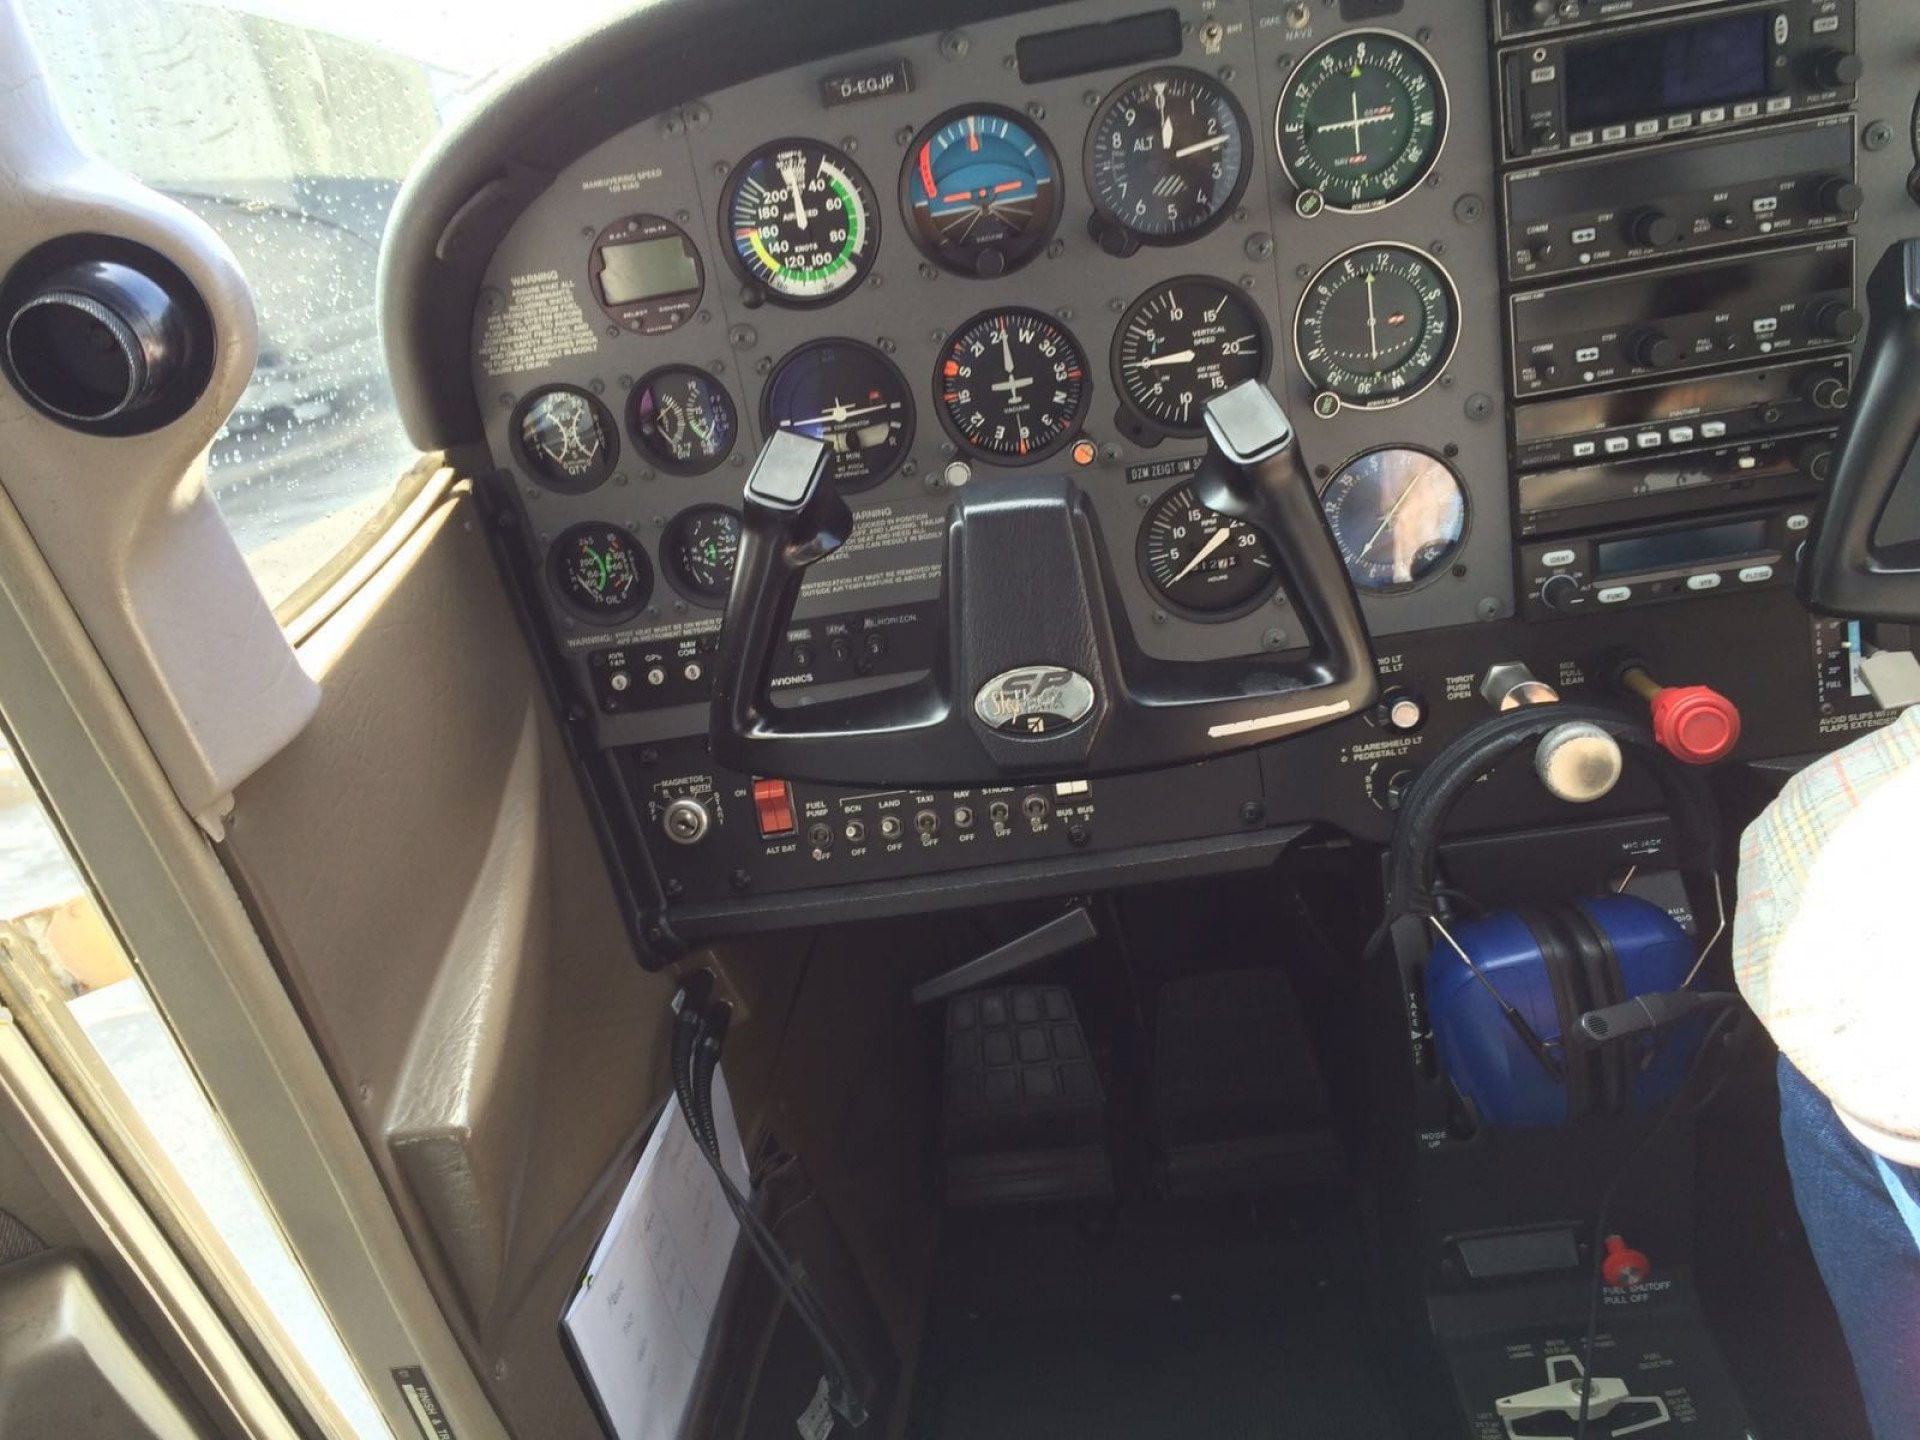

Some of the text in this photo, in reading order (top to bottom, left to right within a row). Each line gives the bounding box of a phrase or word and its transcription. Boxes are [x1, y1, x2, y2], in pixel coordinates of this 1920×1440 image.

[1295, 82, 1309, 99] 12
[1125, 108, 1136, 127] 9
[1420, 110, 1434, 126] W
[1207, 117, 1218, 135] 2
[1285, 122, 1299, 133] E
[1111, 131, 1122, 149] 8
[1133, 136, 1154, 152] ALT
[1211, 162, 1223, 180] 3
[582, 168, 663, 191] MANEUVERING SPEED
[808, 178, 826, 193] 40
[1381, 172, 1399, 190] 33
[762, 189, 788, 205] 200
[1118, 182, 1128, 200] 7
[1197, 188, 1208, 204] 4
[1351, 185, 1362, 200] N
[1712, 192, 1729, 202] NAV
[825, 197, 842, 211] 60
[1135, 198, 1147, 216] 6
[758, 206, 779, 220] 180
[1167, 203, 1178, 220] 5
[758, 225, 779, 239] 160
[829, 228, 846, 243] 80
[768, 239, 789, 254] 140
[794, 242, 818, 253] KNOTS
[784, 254, 806, 269] 120
[811, 252, 833, 266] 100
[1376, 252, 1390, 266] 12
[1344, 259, 1355, 274] E
[1408, 262, 1422, 277] 15
[510, 269, 559, 287] WARNING
[1317, 284, 1328, 295] 6
[1428, 287, 1442, 301] S
[1170, 308, 1183, 321] 10
[1203, 310, 1217, 323] 15
[1714, 313, 1730, 323] NAV
[1304, 317, 1316, 327] 3
[1432, 320, 1445, 335] 21
[1018, 328, 1036, 345] W
[1146, 329, 1156, 343] 5
[1192, 325, 1226, 337] VERTICAL
[1156, 336, 1165, 344] UP
[1193, 336, 1216, 347] SPEED
[970, 340, 985, 358] 21
[1038, 339, 1057, 358] 30
[1221, 341, 1240, 356] 20
[1307, 347, 1324, 361] N
[959, 366, 972, 378] S
[1053, 361, 1068, 382] 33
[1206, 363, 1221, 372] FEET
[1211, 377, 1225, 390] 15
[1326, 371, 1343, 387] 33
[1391, 374, 1406, 390] W
[1153, 382, 1163, 395] 5
[1357, 382, 1372, 395] 30
[958, 389, 972, 404] 15
[1052, 390, 1068, 405] N
[1179, 391, 1193, 405] 10
[1003, 404, 1031, 414] VACUUM
[970, 411, 985, 428] 12
[1041, 413, 1053, 427] 3
[994, 425, 1006, 440] E
[567, 465, 589, 476] QTY
[1131, 467, 1149, 480] DZM
[1188, 508, 1201, 522] 15
[1172, 526, 1186, 539] 10
[1237, 534, 1256, 548] 30
[1170, 547, 1180, 560] 5
[853, 575, 864, 583] KIT
[864, 571, 885, 581] MUST
[896, 565, 930, 576] REMOVED
[844, 578, 894, 592] TEMPERATURE
[903, 572, 927, 583] ABOVE
[1606, 591, 1625, 600] FUNC
[644, 653, 663, 663] GPS
[677, 648, 697, 658] COM
[770, 673, 814, 687] AVIONICS
[1445, 673, 1474, 685] THROT
[1560, 675, 1585, 686] LEAN
[1446, 682, 1471, 693] PUSH
[1446, 690, 1472, 701] OPEN
[1820, 711, 1874, 726] AVOID SLIPS
[1820, 723, 1849, 734] FLAPS
[1351, 735, 1424, 754] GLARESHIELD LT
[1352, 746, 1408, 762] PEDESTAL LT
[661, 775, 704, 788] MAGNETOS
[689, 784, 712, 793] BOTH
[734, 789, 747, 797] ON
[878, 789, 971, 809] LAND TAXI NAV
[805, 800, 827, 810] FUEL
[844, 804, 863, 815] BCN
[1056, 805, 1095, 817] BUS BUS
[805, 808, 829, 818] PUMP
[1032, 823, 1049, 833] OFF
[959, 833, 975, 843] OFF
[766, 843, 797, 855] ALT BAT
[851, 847, 867, 857] OFF
[886, 843, 903, 852] OFF
[1421, 1130, 1447, 1142] NOSE
[1428, 1138, 1441, 1149] UP
[1602, 1280, 1672, 1295] FUEL SHUTOFF
[1603, 1292, 1649, 1305] PULL OFF
